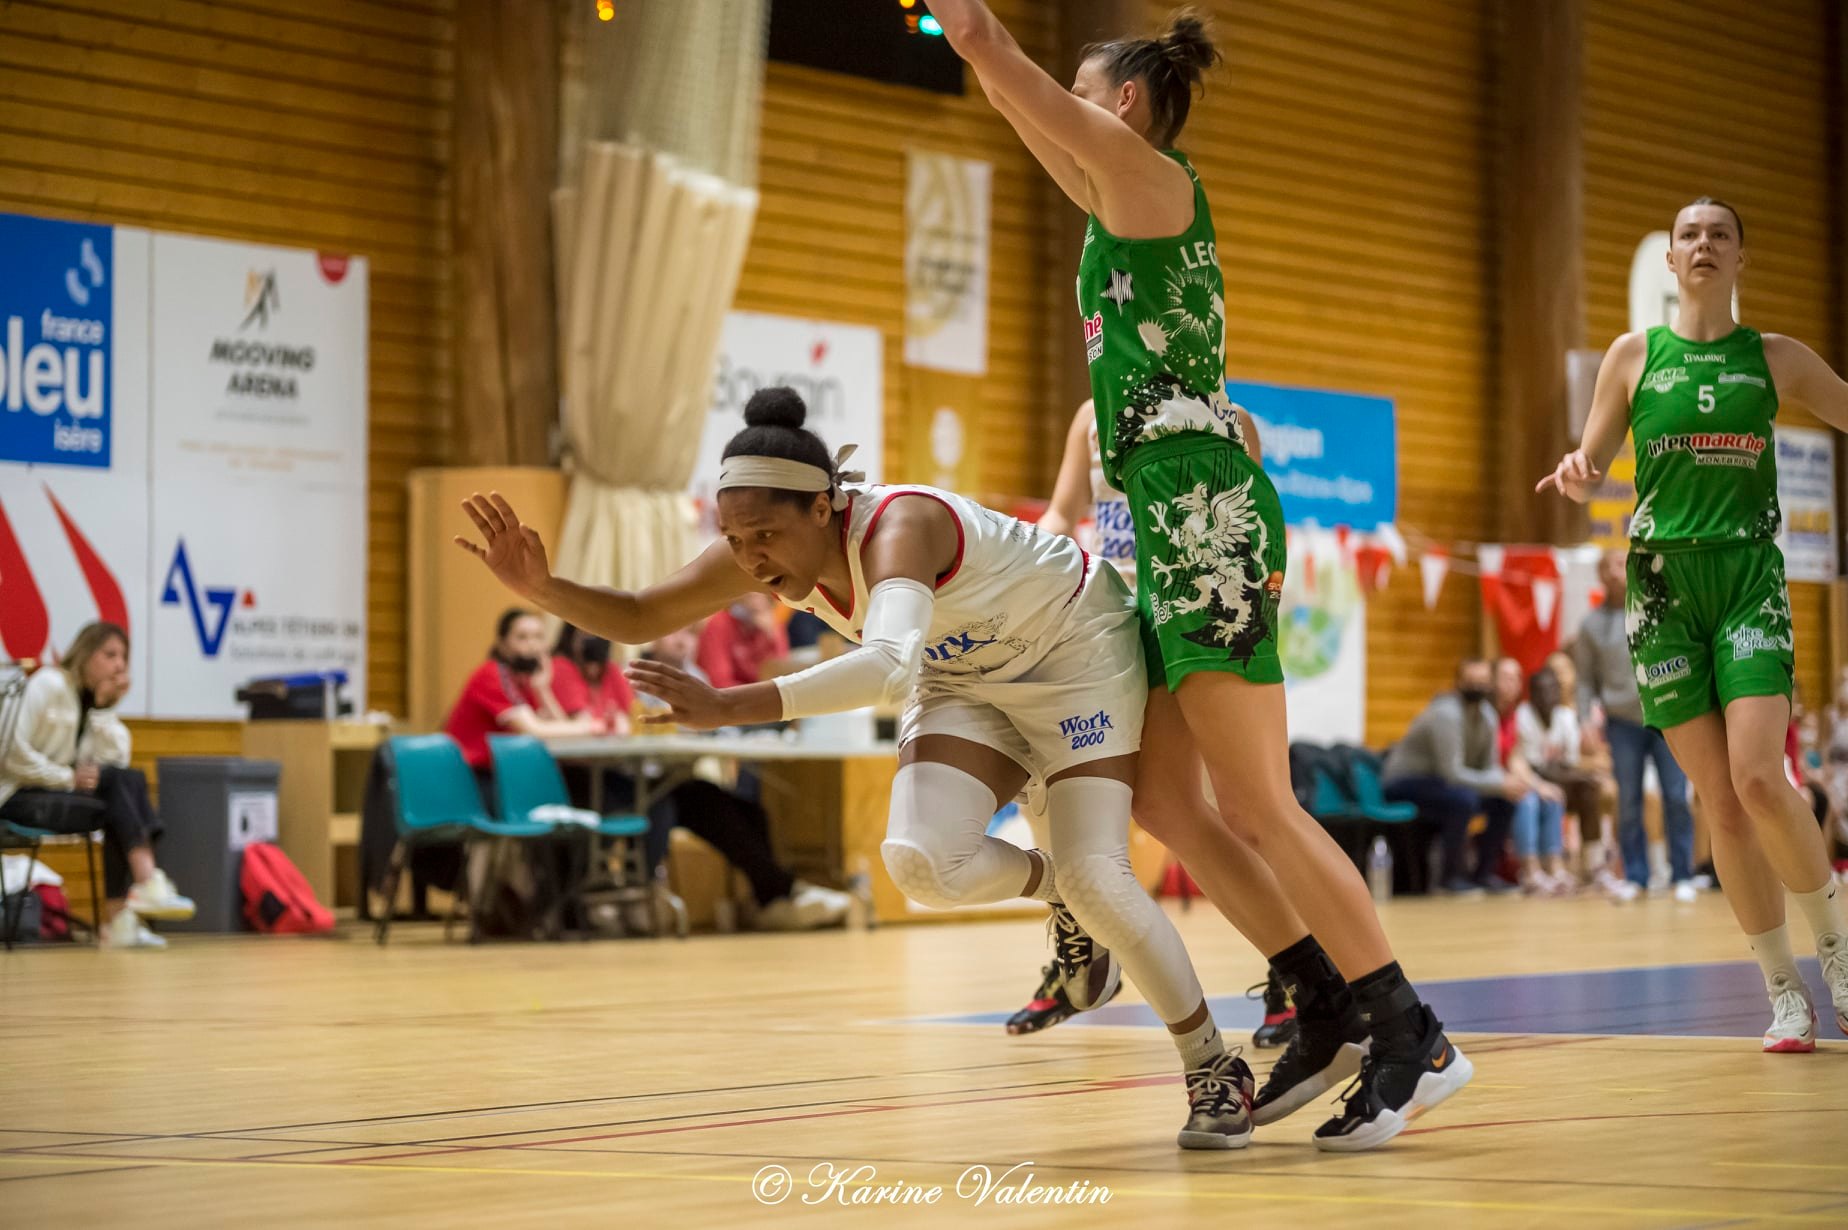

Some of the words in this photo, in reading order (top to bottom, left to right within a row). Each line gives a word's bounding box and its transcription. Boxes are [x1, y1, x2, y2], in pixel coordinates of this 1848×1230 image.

[41, 308, 104, 344] france
[0, 315, 104, 418] leu
[209, 338, 316, 372] MOOVING
[1683, 353, 1726, 364] SPALDING
[226, 371, 298, 398] ARENA
[1697, 384, 1716, 413] 5
[1059, 710, 1114, 736] Work
[1071, 730, 1105, 750] 2000
